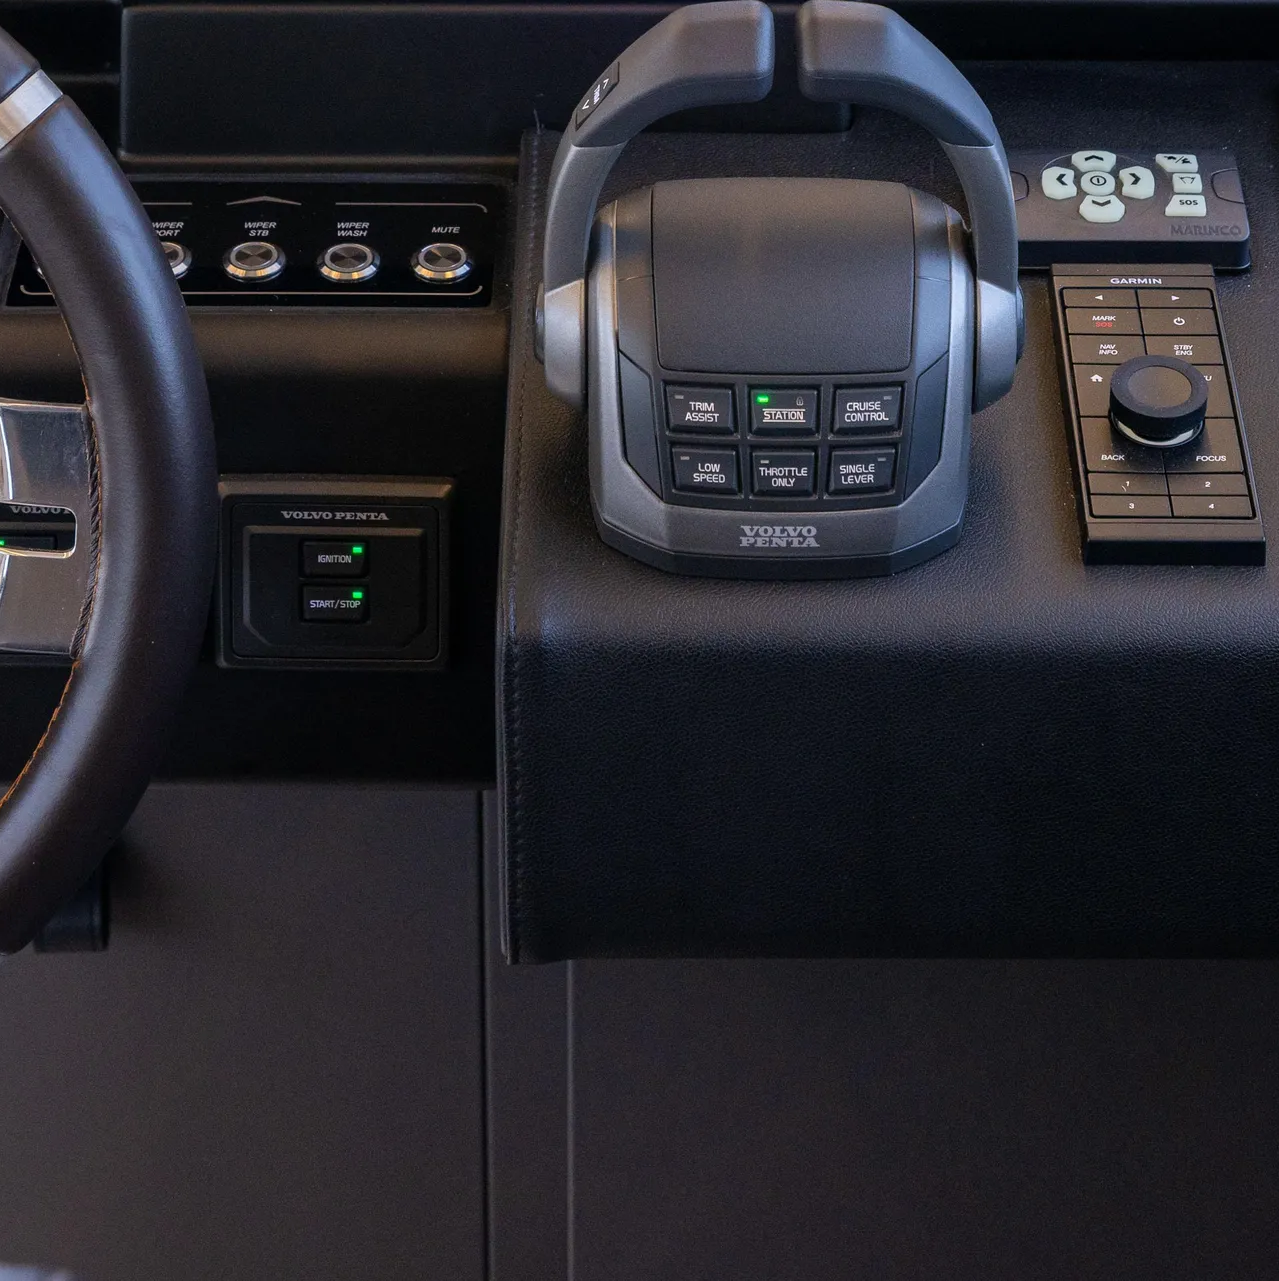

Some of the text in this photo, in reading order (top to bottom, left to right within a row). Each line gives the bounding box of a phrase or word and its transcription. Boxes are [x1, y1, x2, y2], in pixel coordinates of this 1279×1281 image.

[1170, 224, 1242, 236] MARINCO
[690, 402, 715, 412] TRIM
[846, 401, 881, 411] CRUISE
[685, 412, 719, 422] ASSIST
[764, 411, 804, 420] STATION
[845, 412, 889, 422] CONTROL
[698, 464, 720, 472] LOW
[759, 467, 808, 476] THROTTLE
[839, 464, 875, 474] SINGLE
[693, 473, 725, 483] SPEED
[771, 478, 796, 487] ONLY
[841, 474, 874, 484] LEVER
[9, 506, 60, 514] VOLVO
[281, 511, 389, 520] VOLVO PENTA
[740, 526, 817, 537] VOLVO
[740, 537, 820, 547] PENTA
[318, 555, 351, 563] IGNITION
[310, 599, 361, 609] START/STOP
